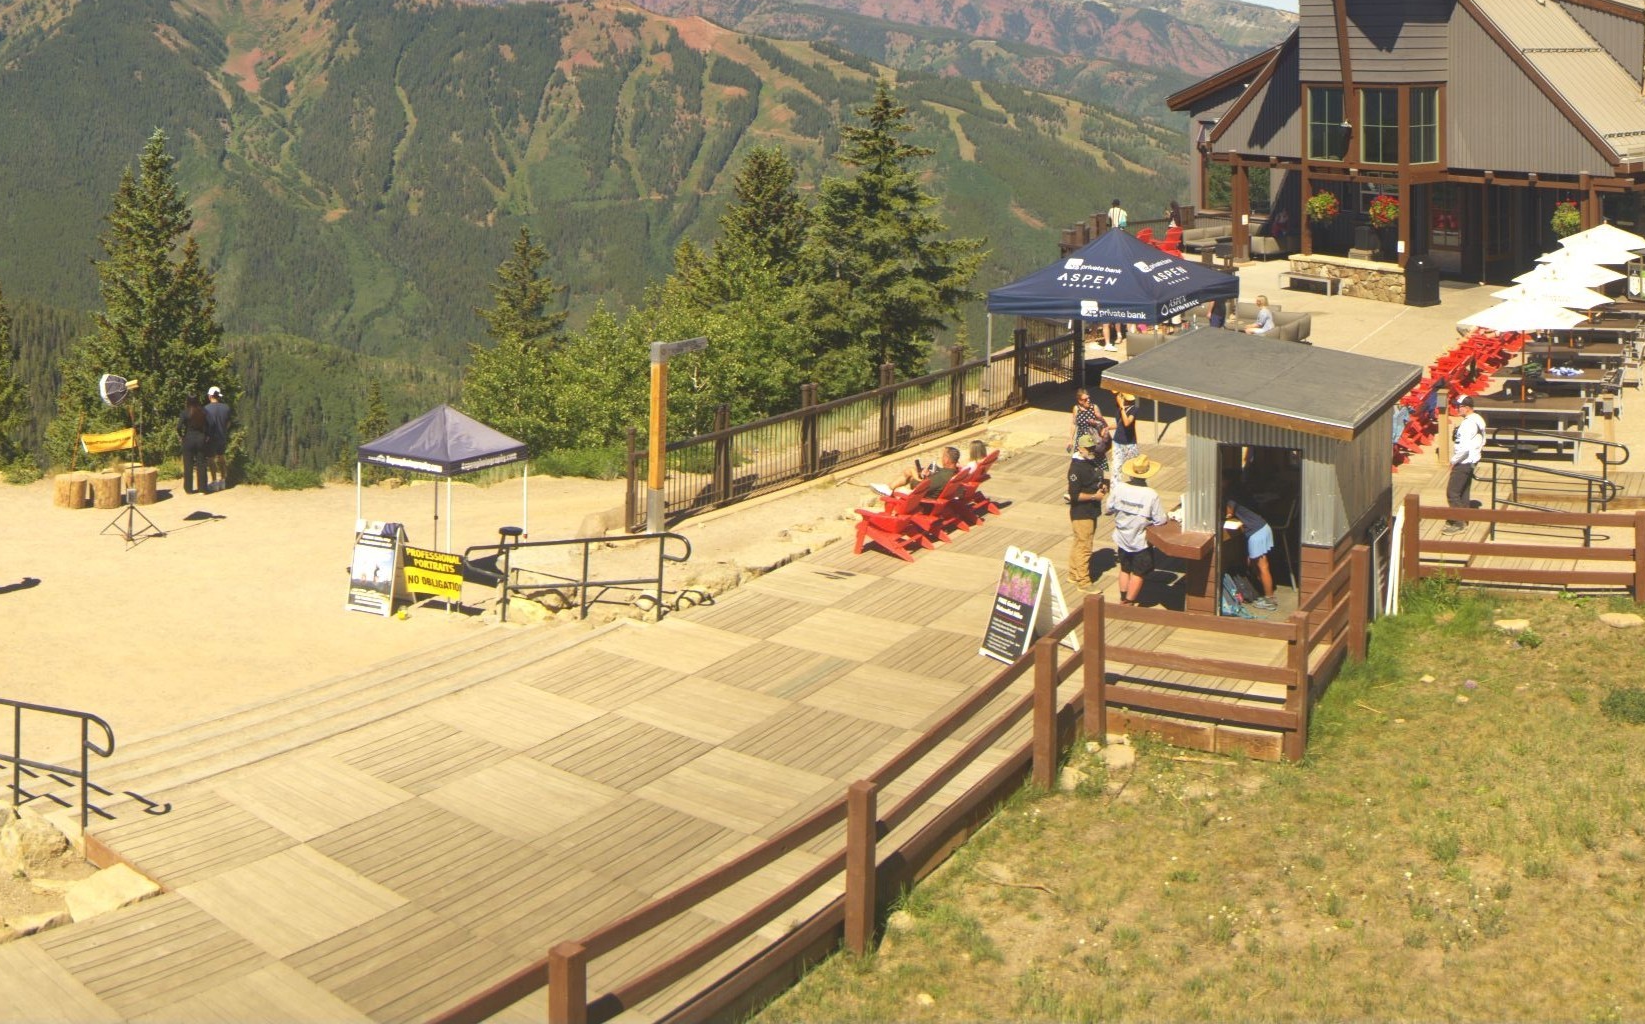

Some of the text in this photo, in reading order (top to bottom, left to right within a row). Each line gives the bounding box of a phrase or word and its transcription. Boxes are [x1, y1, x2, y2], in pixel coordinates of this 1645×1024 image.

[1104, 266, 1122, 274] bank
[1153, 266, 1188, 283] ASPEN
[1057, 273, 1117, 285] ASPEN
[1099, 308, 1125, 318] private
[1126, 309, 1146, 320] bank
[405, 547, 462, 565] PROFESSIONAL
[414, 558, 456, 573] PORTRAITS
[408, 574, 420, 585] NO
